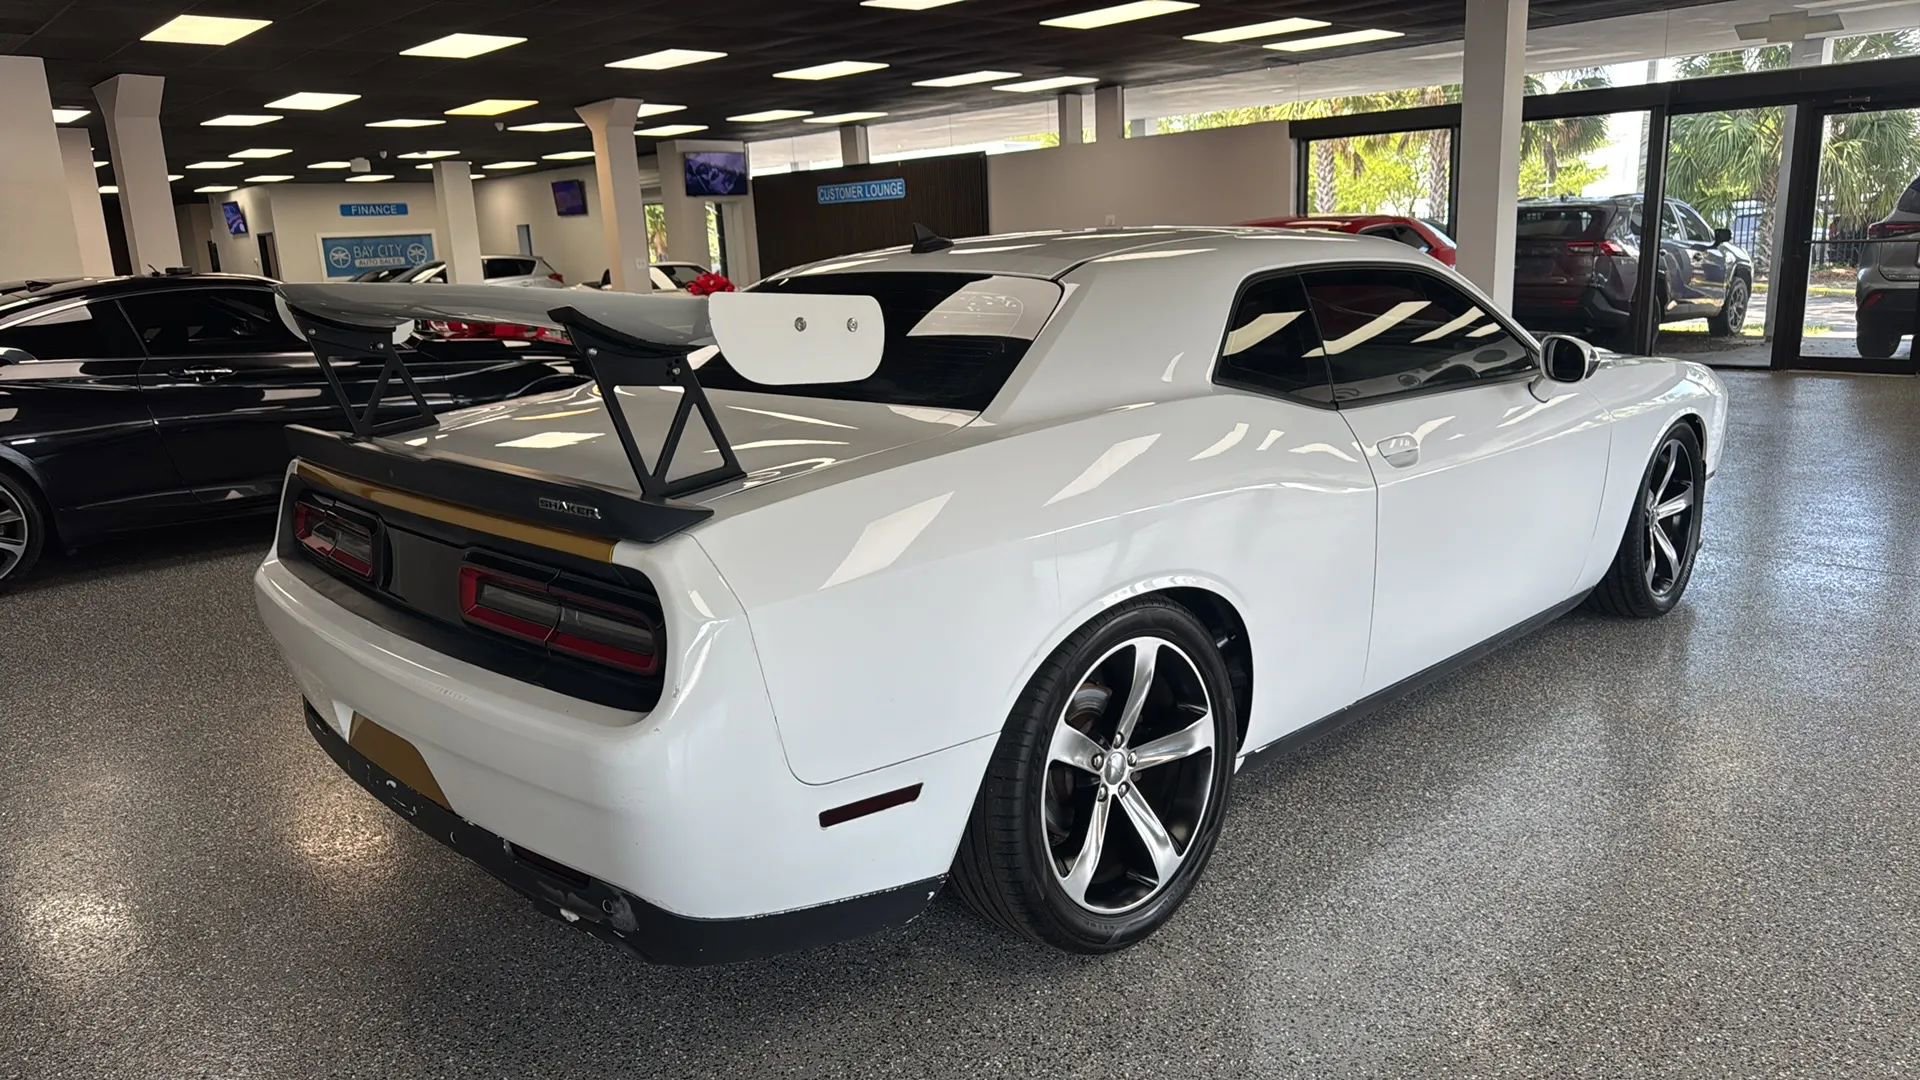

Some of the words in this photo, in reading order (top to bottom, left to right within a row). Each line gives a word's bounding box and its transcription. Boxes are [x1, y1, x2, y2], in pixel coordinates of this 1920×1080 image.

[819, 186, 863, 201] CUSTOMER
[865, 182, 903, 197] LOUNGE
[351, 204, 397, 215] FINANCE
[353, 245, 374, 258] BAY
[377, 244, 402, 257] CITY
[539, 497, 601, 519] SHAKER
